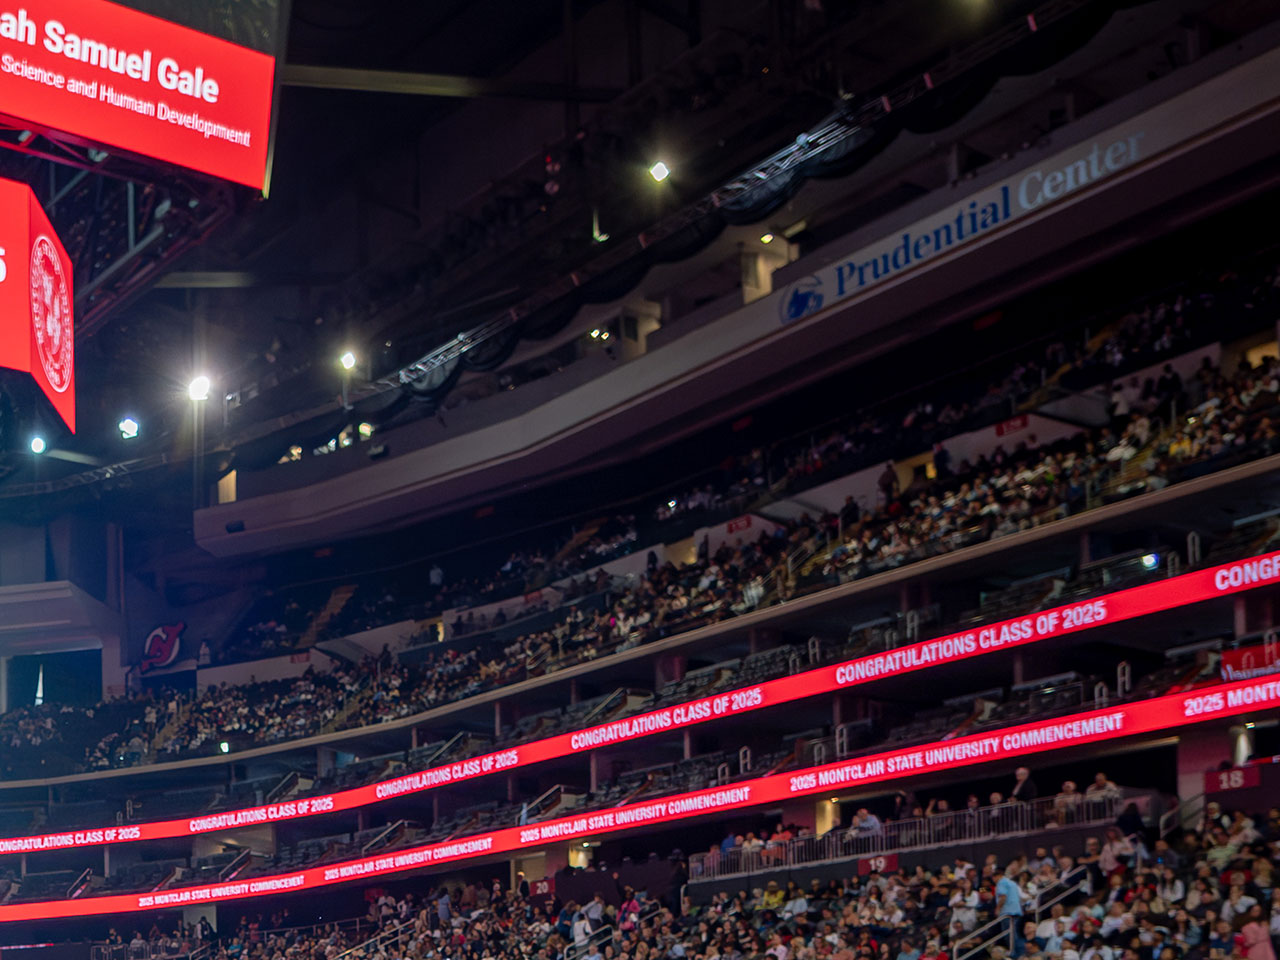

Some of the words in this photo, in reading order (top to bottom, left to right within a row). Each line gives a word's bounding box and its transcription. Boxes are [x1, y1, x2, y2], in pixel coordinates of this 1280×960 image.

[44, 21, 151, 81] Samuel
[158, 58, 219, 102] Gale
[1, 54, 64, 88] Science
[67, 79, 97, 98] and
[100, 85, 155, 116] Human
[157, 103, 250, 146] Development
[835, 185, 1012, 297] Prudential
[1019, 130, 1146, 212] Center
[836, 634, 976, 684] CONGRATULATIONS
[979, 620, 1032, 648] CLASS
[1037, 612, 1059, 634] OF
[1062, 600, 1106, 628] 2025
[571, 711, 671, 749] CONGRATULATIONS
[673, 701, 711, 724] CLASS
[713, 696, 729, 714] OF
[731, 688, 761, 710] 2025
[1184, 693, 1224, 716] 2025
[376, 768, 451, 798] CONGRATULATIONS
[452, 760, 480, 779] CLASS
[482, 756, 493, 771] OF
[495, 750, 518, 768] 2025
[790, 773, 816, 791] 2025
[819, 760, 884, 785] MONTCLAIR
[887, 752, 923, 772] STATE
[926, 738, 999, 765] UNIVERSITY
[1003, 713, 1123, 750] COMMENCEMENT
[1219, 770, 1244, 790] 18
[75, 831, 103, 844] CLASS
[105, 829, 116, 841] OF
[118, 827, 140, 839] 2025
[190, 808, 267, 831] CONGRATULATIONS
[268, 804, 296, 818] CLASS
[298, 801, 309, 814] OF
[311, 797, 333, 812] 2025
[521, 828, 539, 842] 2025
[541, 819, 587, 838] MONTCLAIR
[589, 814, 614, 829] STATE
[616, 804, 666, 824] UNIVERSITY
[669, 787, 750, 814] COMMENCEMENT
[325, 868, 339, 880] 2025
[340, 862, 374, 876] MONTCLAIR
[375, 858, 394, 870] STATE
[395, 850, 432, 866] UNIVERSITY
[433, 837, 492, 859] COMMENCEMENT
[869, 857, 885, 872] 19
[139, 896, 154, 906] 2025
[155, 892, 190, 904] MONTCLAIR
[192, 889, 210, 900] STATE
[211, 884, 249, 897] UNIVERSITY
[250, 875, 304, 892] COMMENCEMENT
[536, 883, 548, 895] 20
